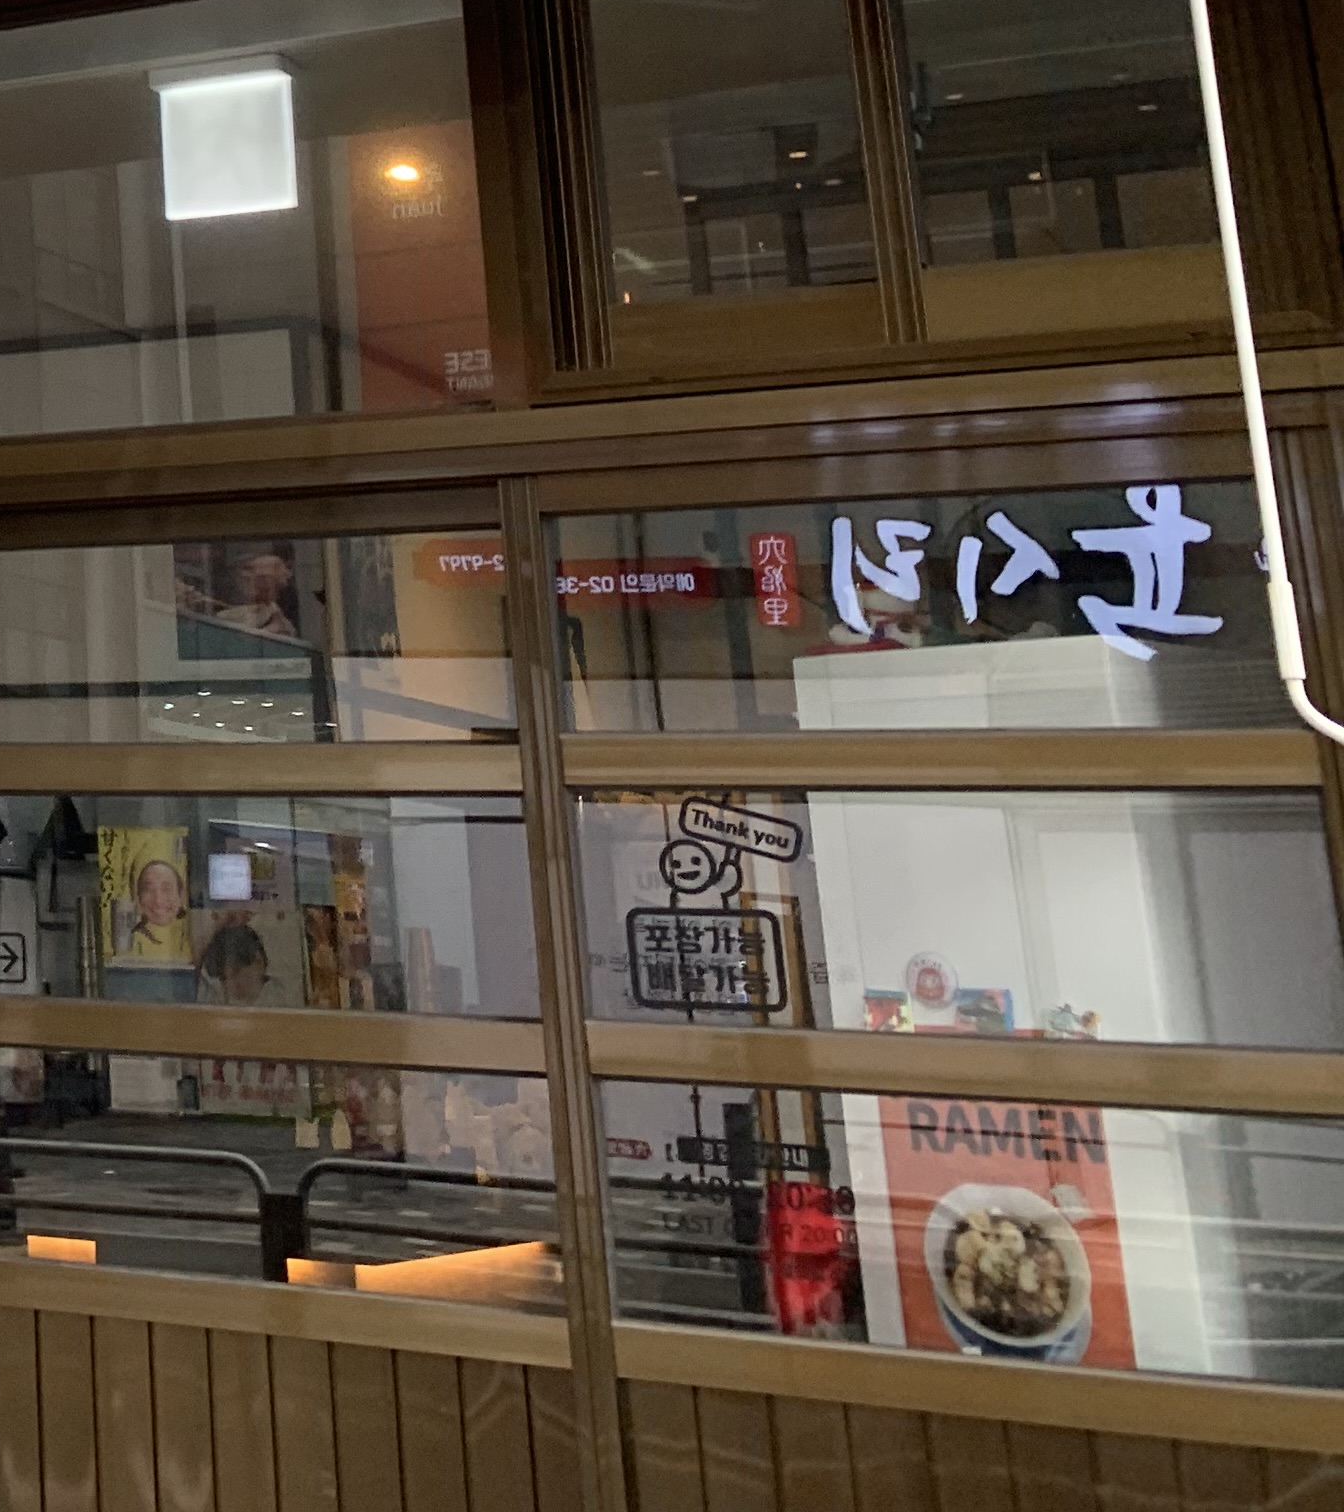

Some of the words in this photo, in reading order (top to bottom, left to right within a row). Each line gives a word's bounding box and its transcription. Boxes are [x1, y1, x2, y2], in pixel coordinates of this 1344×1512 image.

[691, 807, 751, 840] Thank
[752, 828, 790, 849] you
[644, 923, 766, 955] 포장가능
[647, 962, 770, 994] 배달가능
[906, 1100, 1108, 1165] RAMEN
